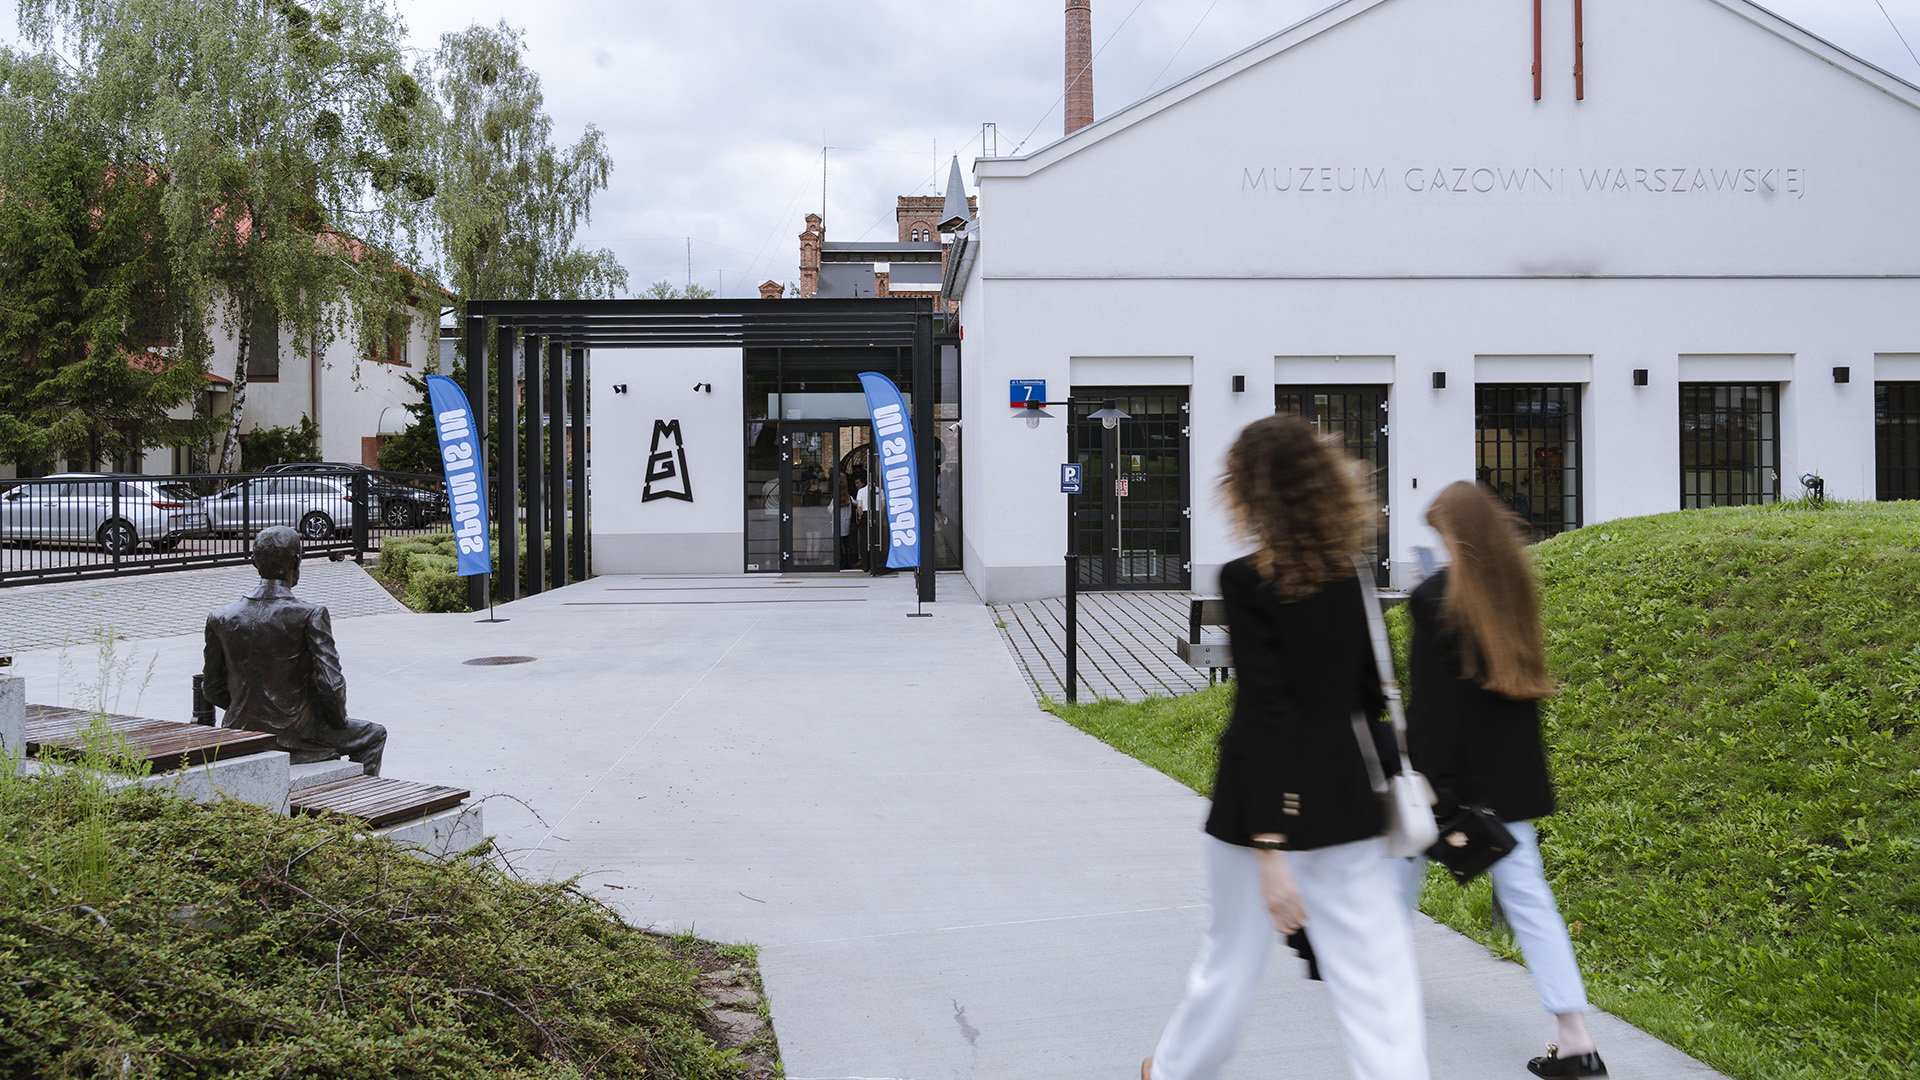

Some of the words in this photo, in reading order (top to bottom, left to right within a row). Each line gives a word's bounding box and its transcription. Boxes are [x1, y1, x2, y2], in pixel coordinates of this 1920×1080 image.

[1241, 167, 1388, 192] MUZEUM
[1404, 167, 1564, 193] GAZOWNI
[1579, 168, 1806, 199] WARSZAWSKIEJ
[1023, 386, 1032, 401] 7
[1065, 467, 1076, 482] P
